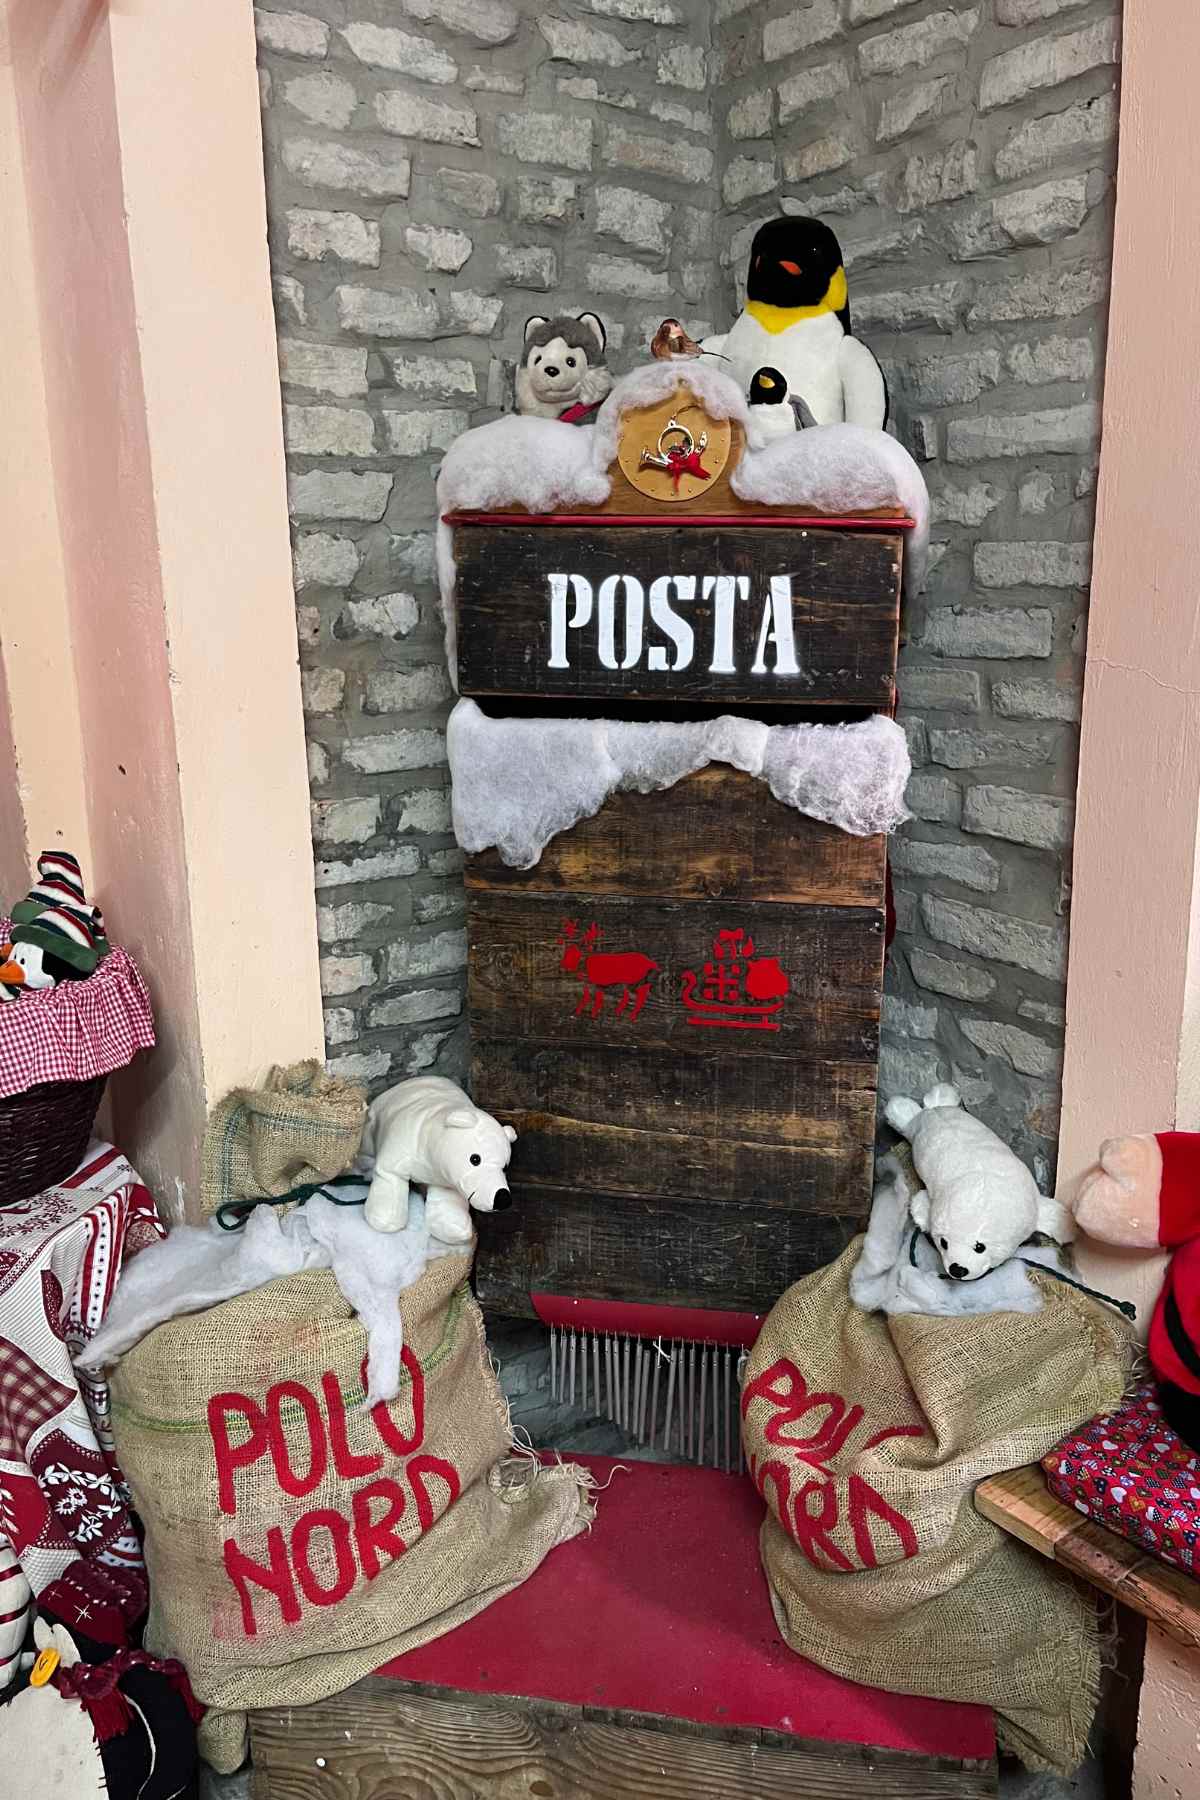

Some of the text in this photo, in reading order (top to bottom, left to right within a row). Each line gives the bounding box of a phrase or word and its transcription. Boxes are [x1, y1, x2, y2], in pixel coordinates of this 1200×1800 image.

[547, 573, 801, 674] POSTA
[207, 1344, 425, 1515] POLO
[223, 1454, 461, 1635] NORD
[750, 1453, 919, 1573] ORD
